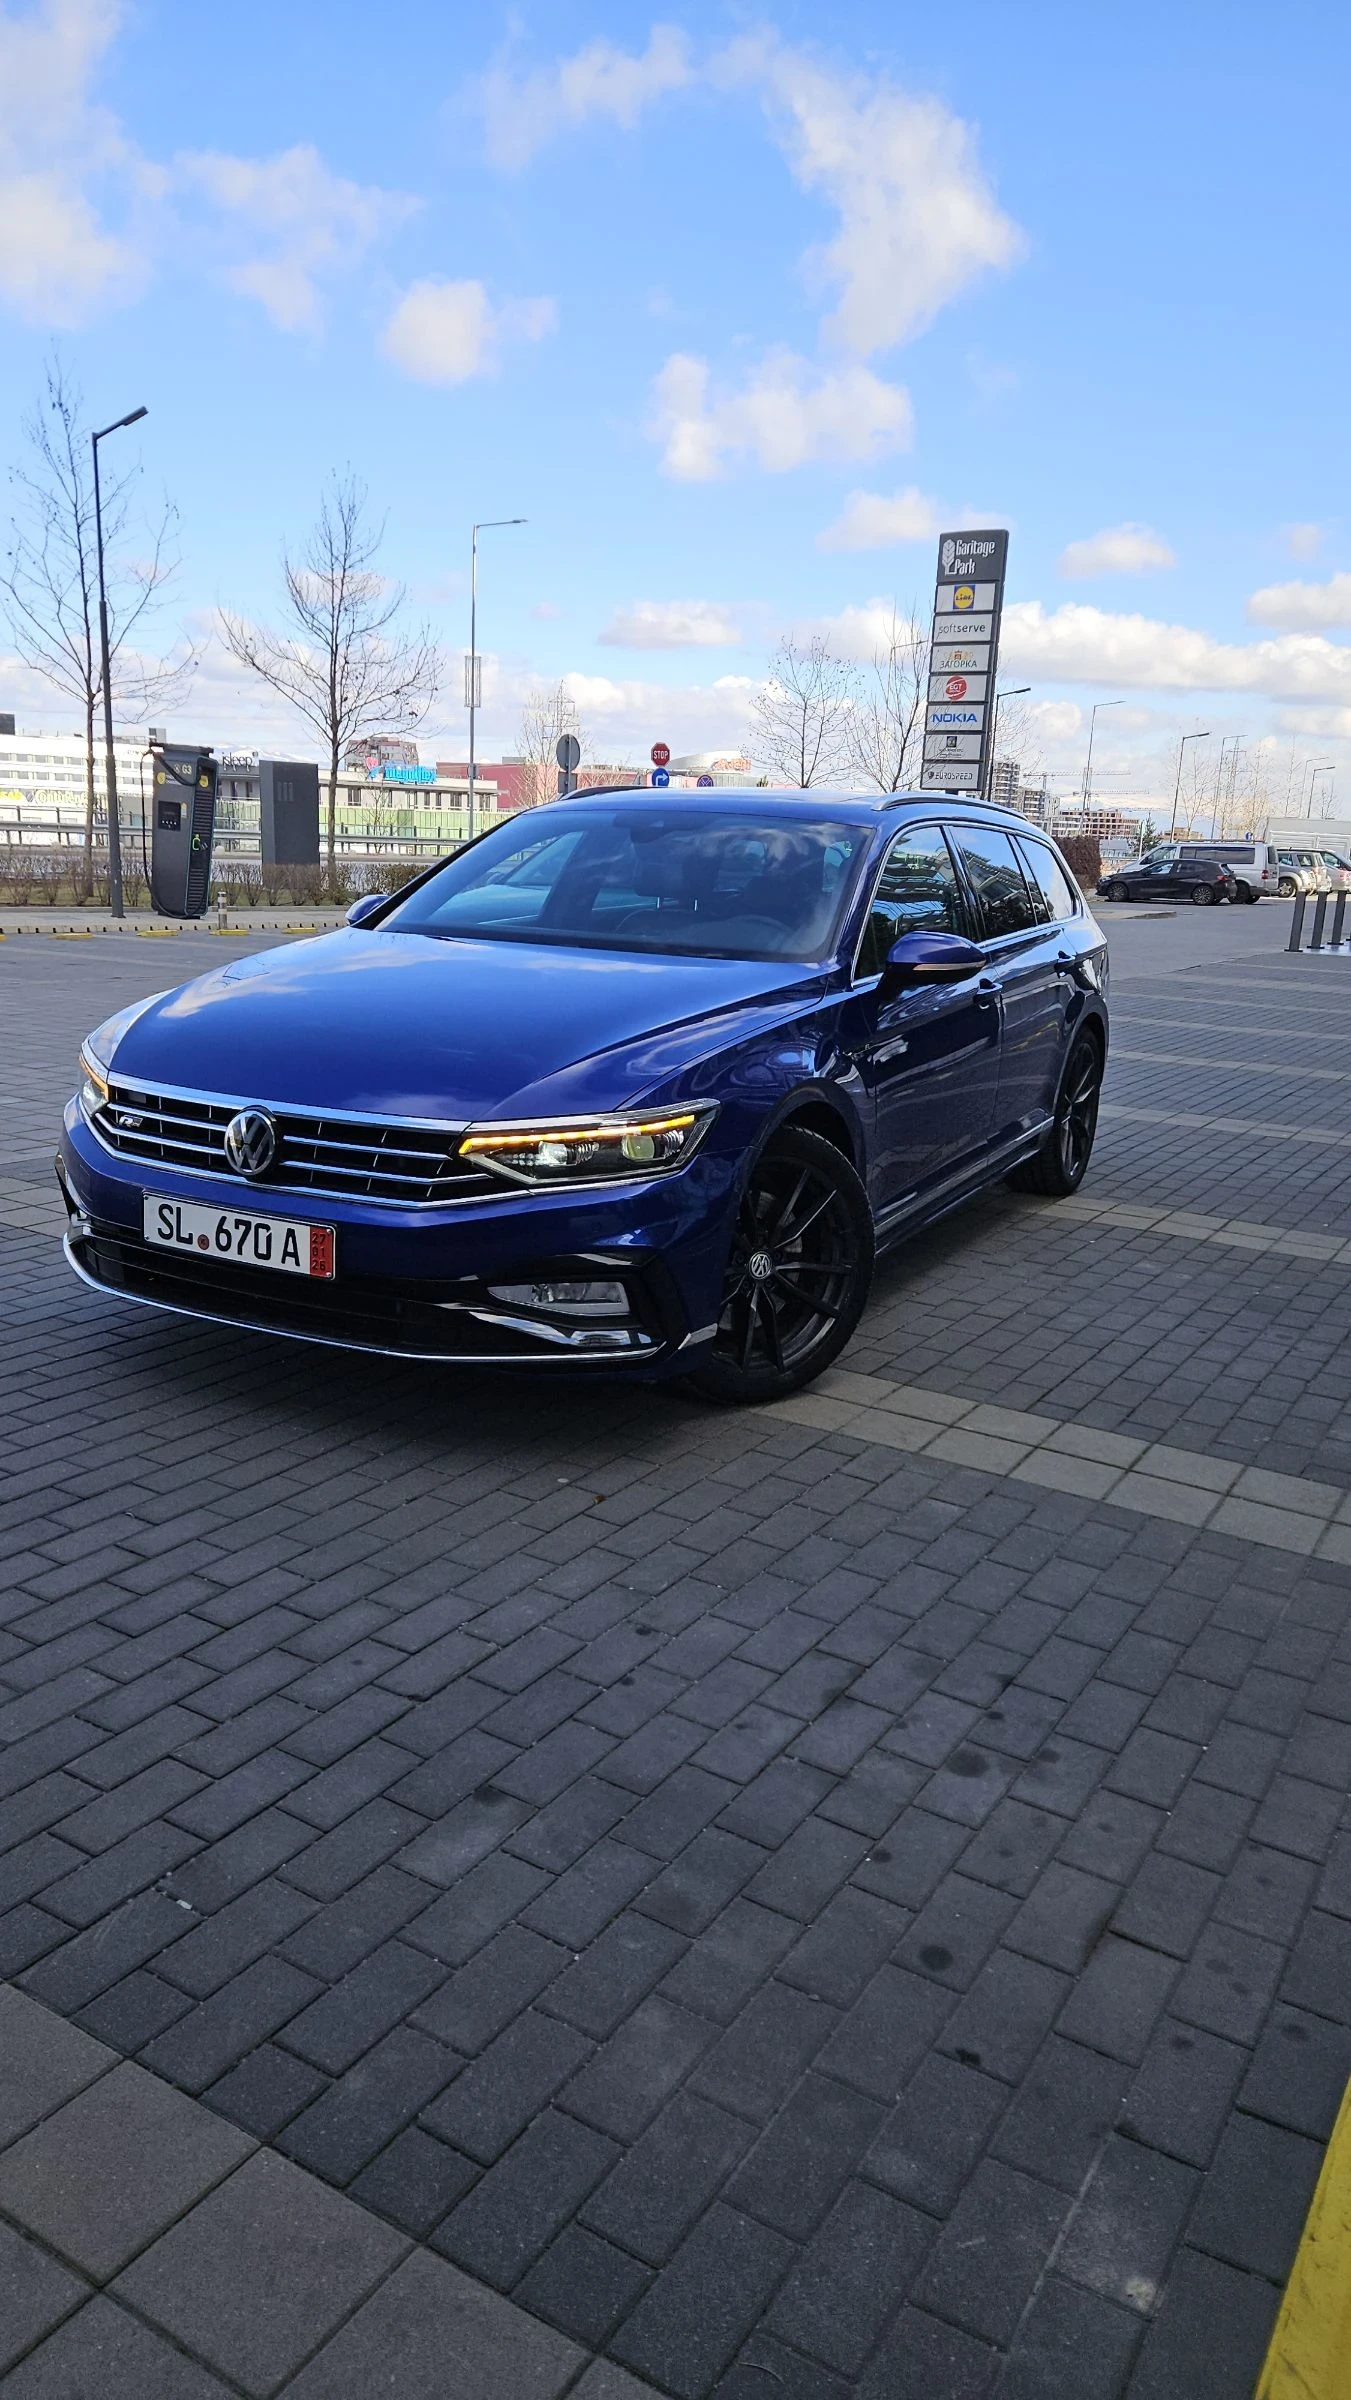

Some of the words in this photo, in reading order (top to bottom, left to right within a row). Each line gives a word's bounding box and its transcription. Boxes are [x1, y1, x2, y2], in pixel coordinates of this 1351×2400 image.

[956, 540, 995, 557] Garitage
[954, 559, 975, 575] Park
[939, 624, 986, 634] softserve
[940, 660, 977, 668] ЗАГОРКА
[932, 713, 977, 723] NOKIA
[653, 750, 669, 760] STOP
[157, 1203, 194, 1245] SL
[311, 1232, 326, 1244] 27
